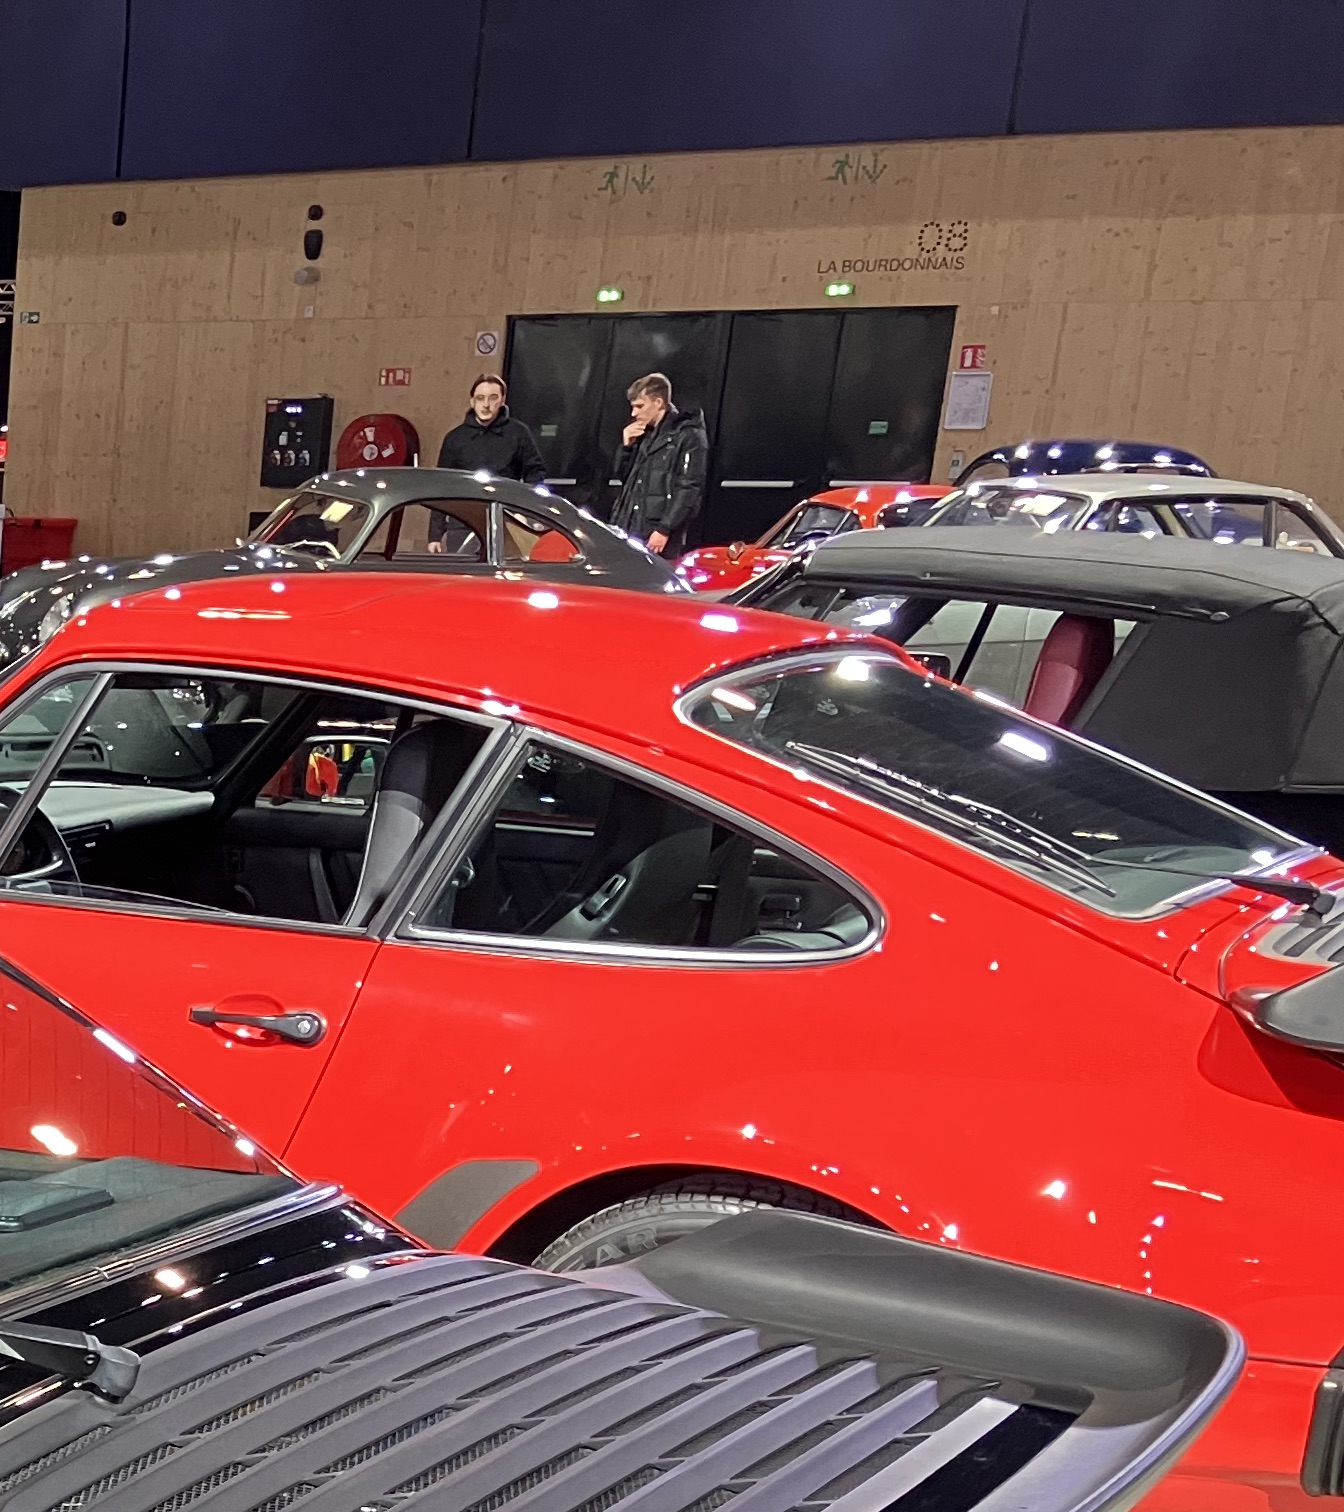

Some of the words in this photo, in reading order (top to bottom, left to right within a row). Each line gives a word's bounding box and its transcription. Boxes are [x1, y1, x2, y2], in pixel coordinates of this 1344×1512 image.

[918, 220, 969, 254] 08
[817, 260, 837, 274] LA
[841, 255, 966, 273] BOURDONNAIS
